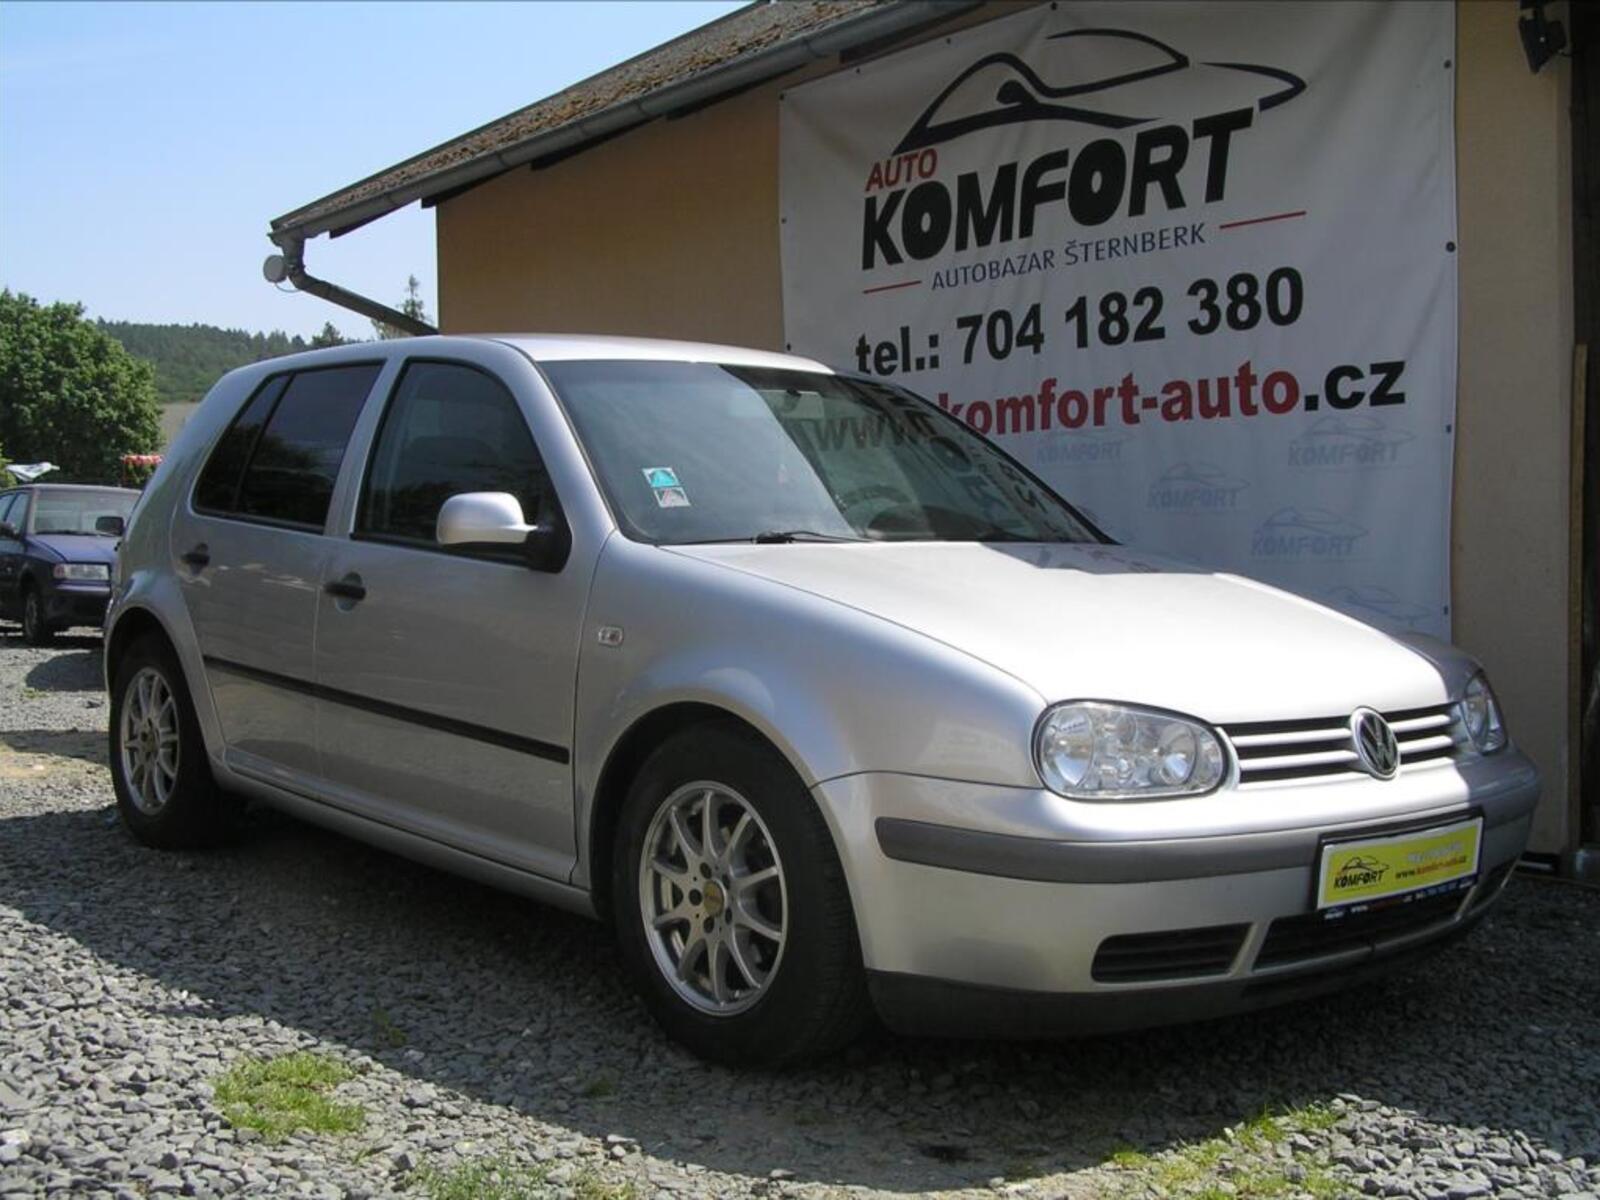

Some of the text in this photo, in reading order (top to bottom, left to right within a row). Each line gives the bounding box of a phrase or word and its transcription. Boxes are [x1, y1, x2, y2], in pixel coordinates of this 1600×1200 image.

[865, 148, 938, 193] AUTO
[862, 107, 1254, 270] KOMFORT
[931, 222, 1207, 291] AUTOBAZAR ŠTERNBERK
[856, 267, 1305, 376] tel.: 704 182 380
[1036, 440, 1124, 464] KOMFORT
[1288, 442, 1402, 467] KOMFORT
[1147, 486, 1240, 510] KOMFORT
[1250, 533, 1358, 557] KOMFORT
[1334, 870, 1385, 889] KOMFORT
